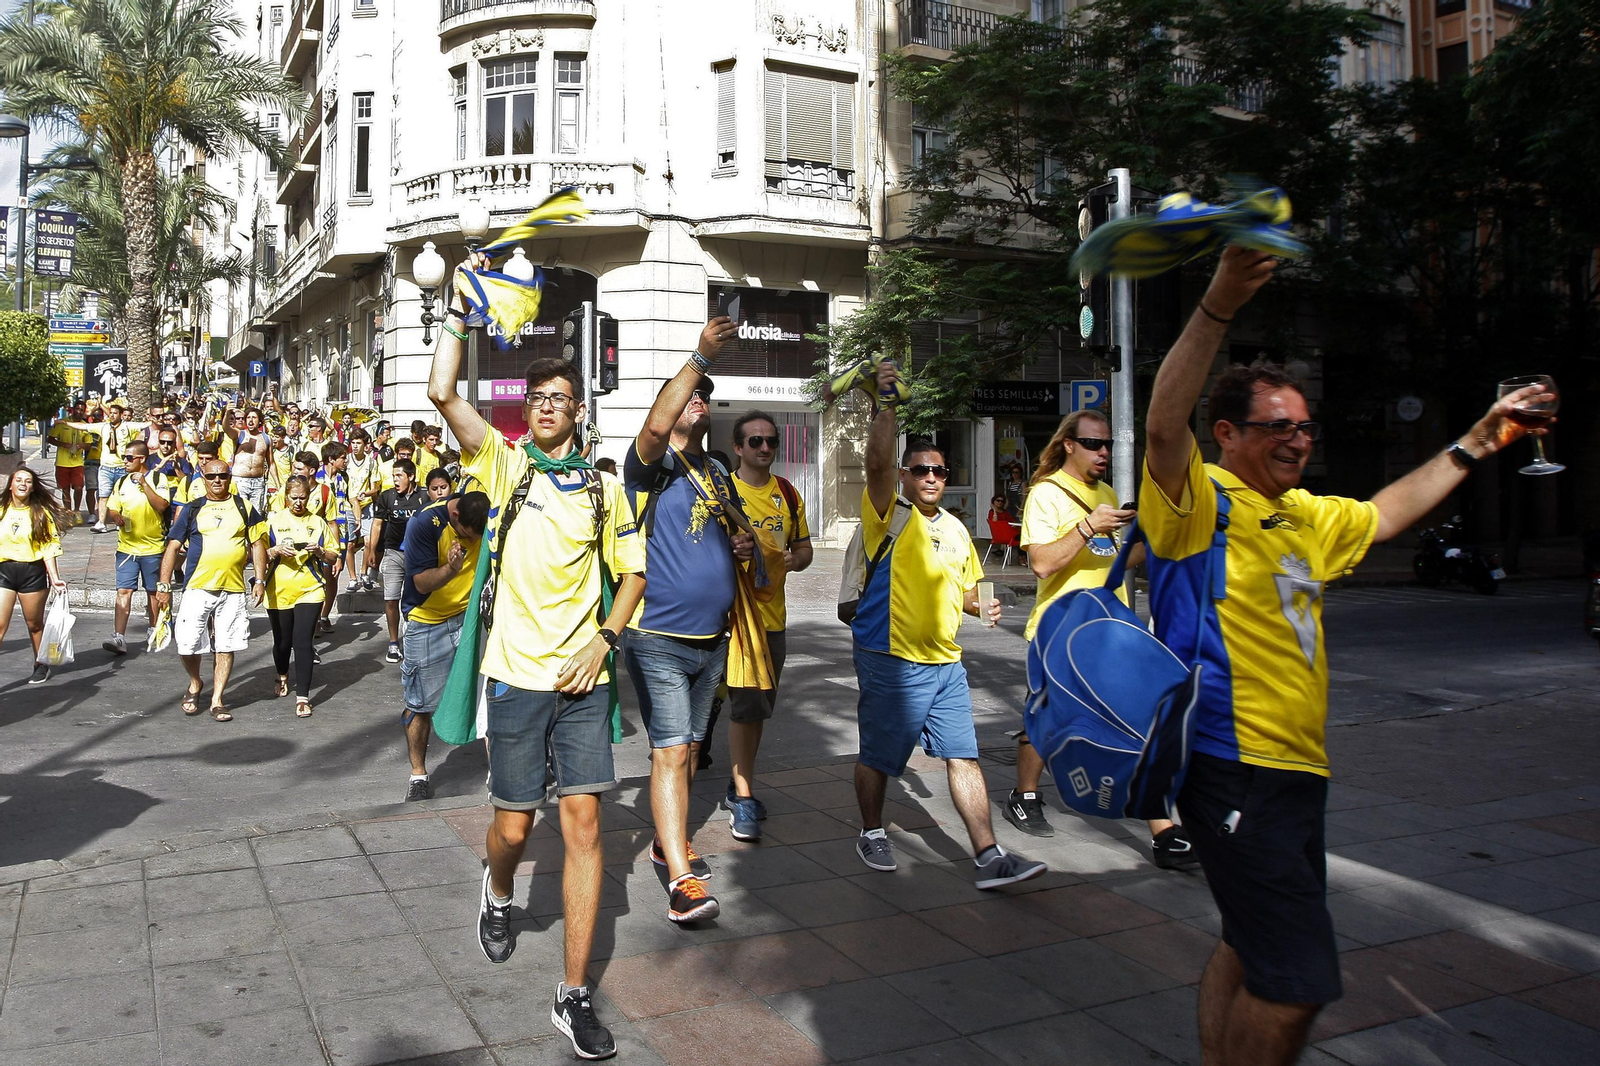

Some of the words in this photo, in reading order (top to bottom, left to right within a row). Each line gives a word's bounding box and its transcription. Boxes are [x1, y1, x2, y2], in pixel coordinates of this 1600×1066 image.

[37, 222, 74, 235] LOQUILLO
[36, 236, 46, 245] LOS
[46, 236, 75, 247] SECRETOS
[37, 247, 72, 258] ELEFANTES
[738, 320, 782, 340] dorsia
[495, 385, 506, 395] 96
[507, 385, 522, 395] 520
[747, 385, 762, 394] 966
[764, 386, 773, 394] 04
[776, 386, 785, 394] 91
[998, 389, 1044, 400] SEMILLAS
[1079, 385, 1099, 411] P
[984, 404, 1011, 412] capricho
[1095, 776, 1114, 809] umbro
